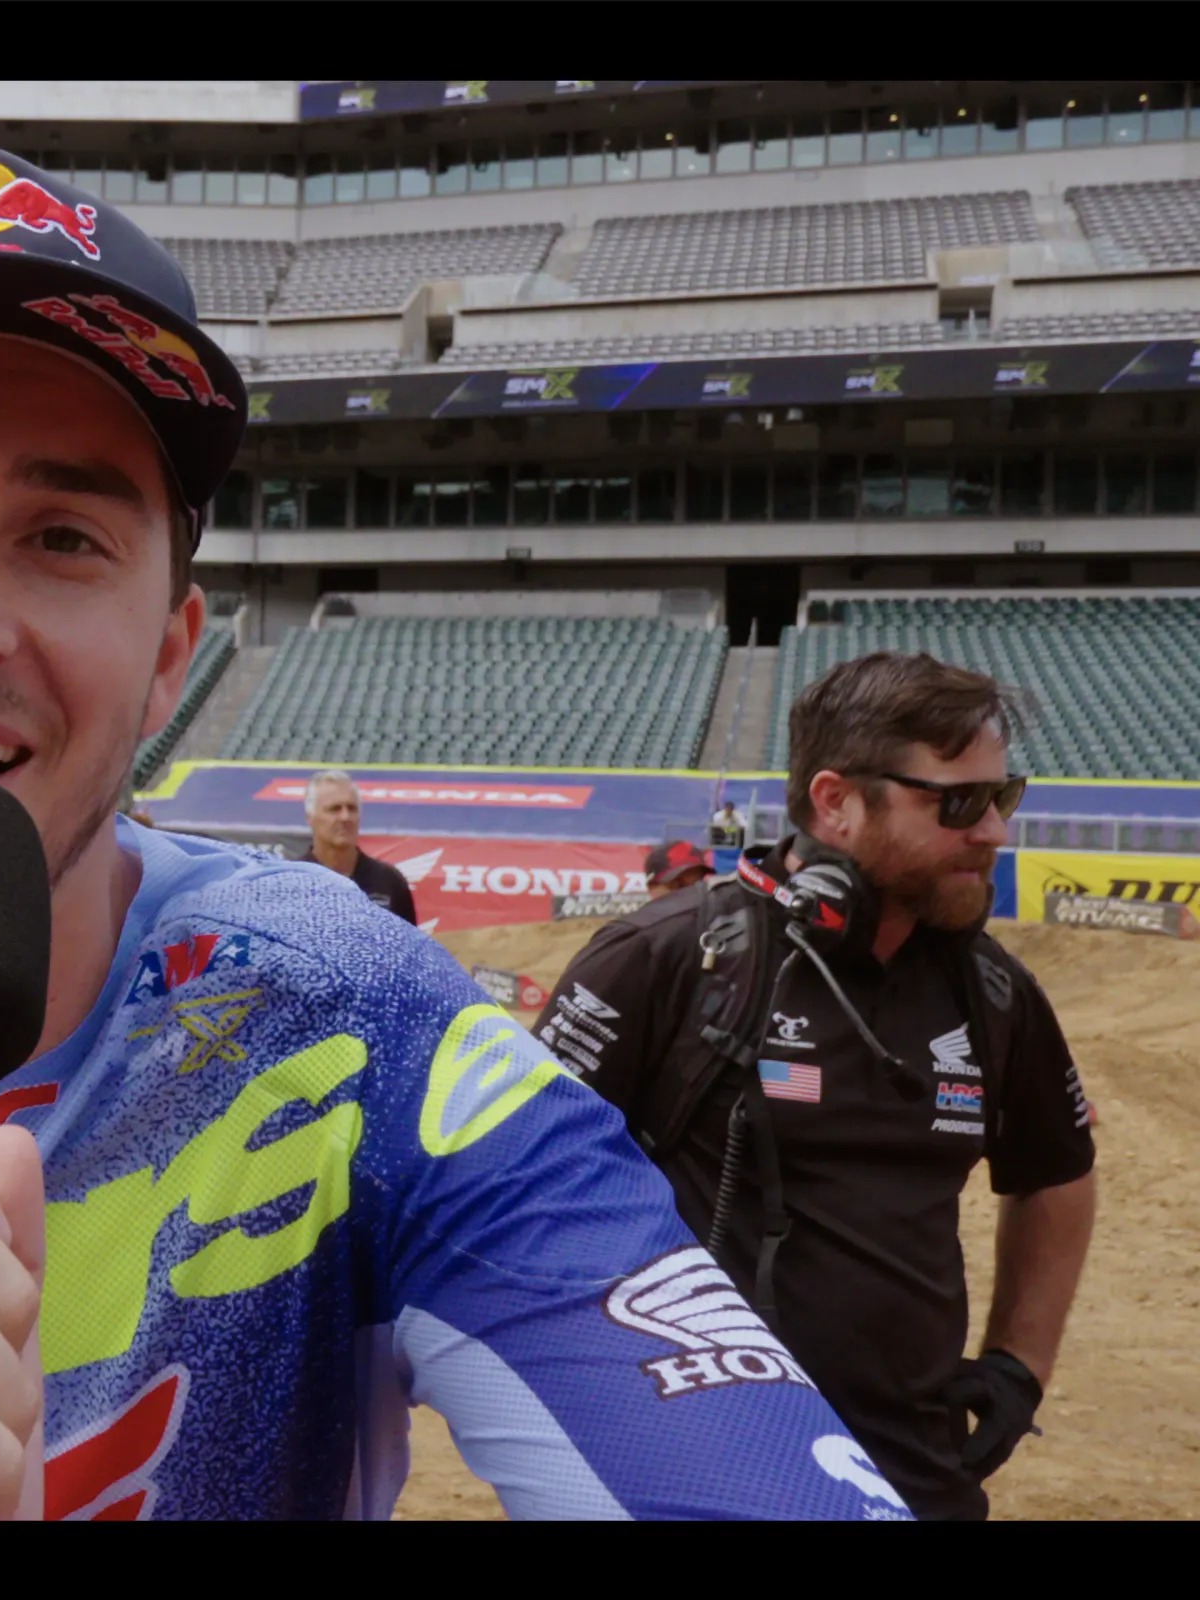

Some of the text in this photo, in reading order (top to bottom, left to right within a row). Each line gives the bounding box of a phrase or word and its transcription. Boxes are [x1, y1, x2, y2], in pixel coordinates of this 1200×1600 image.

[440, 865, 649, 897] HONDA
[123, 933, 253, 1007] AMA
[932, 1060, 983, 1077] HONDA
